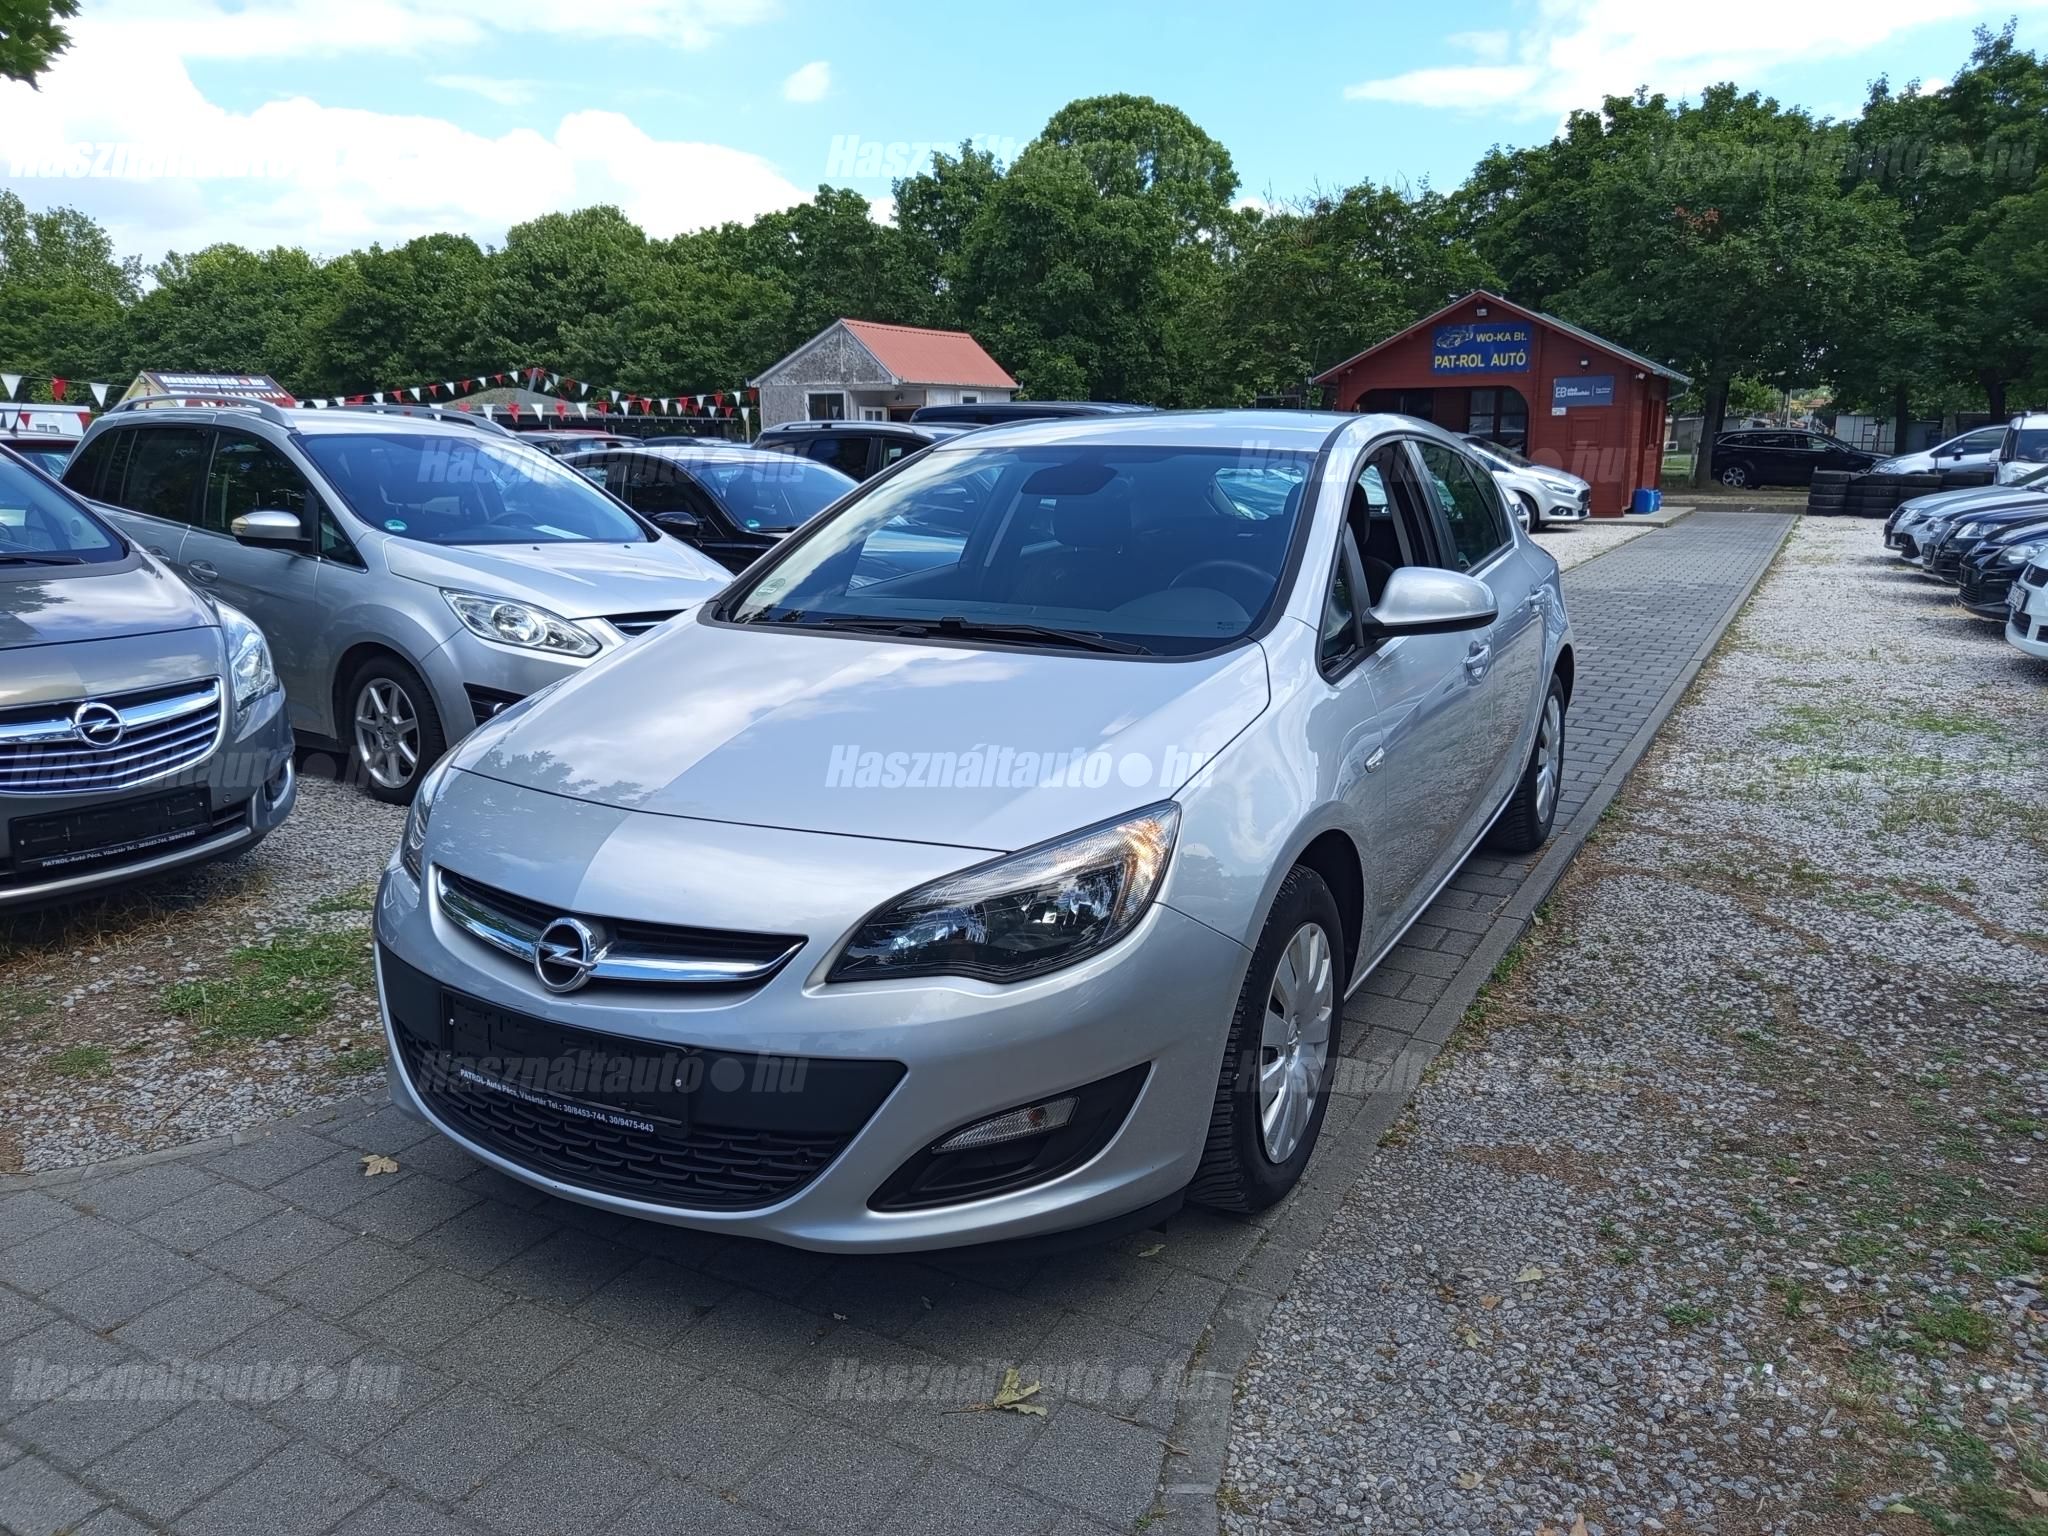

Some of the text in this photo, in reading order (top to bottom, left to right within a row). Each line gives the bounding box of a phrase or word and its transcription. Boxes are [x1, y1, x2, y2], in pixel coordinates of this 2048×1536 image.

[1476, 333, 1511, 342] WO-KA
[1434, 348, 1527, 368] PAT-ROL AUTÓ
[548, 1099, 562, 1110] Tel.:
[563, 1104, 608, 1123] 30/8453-744,
[609, 1115, 654, 1133] 30/9475-643
